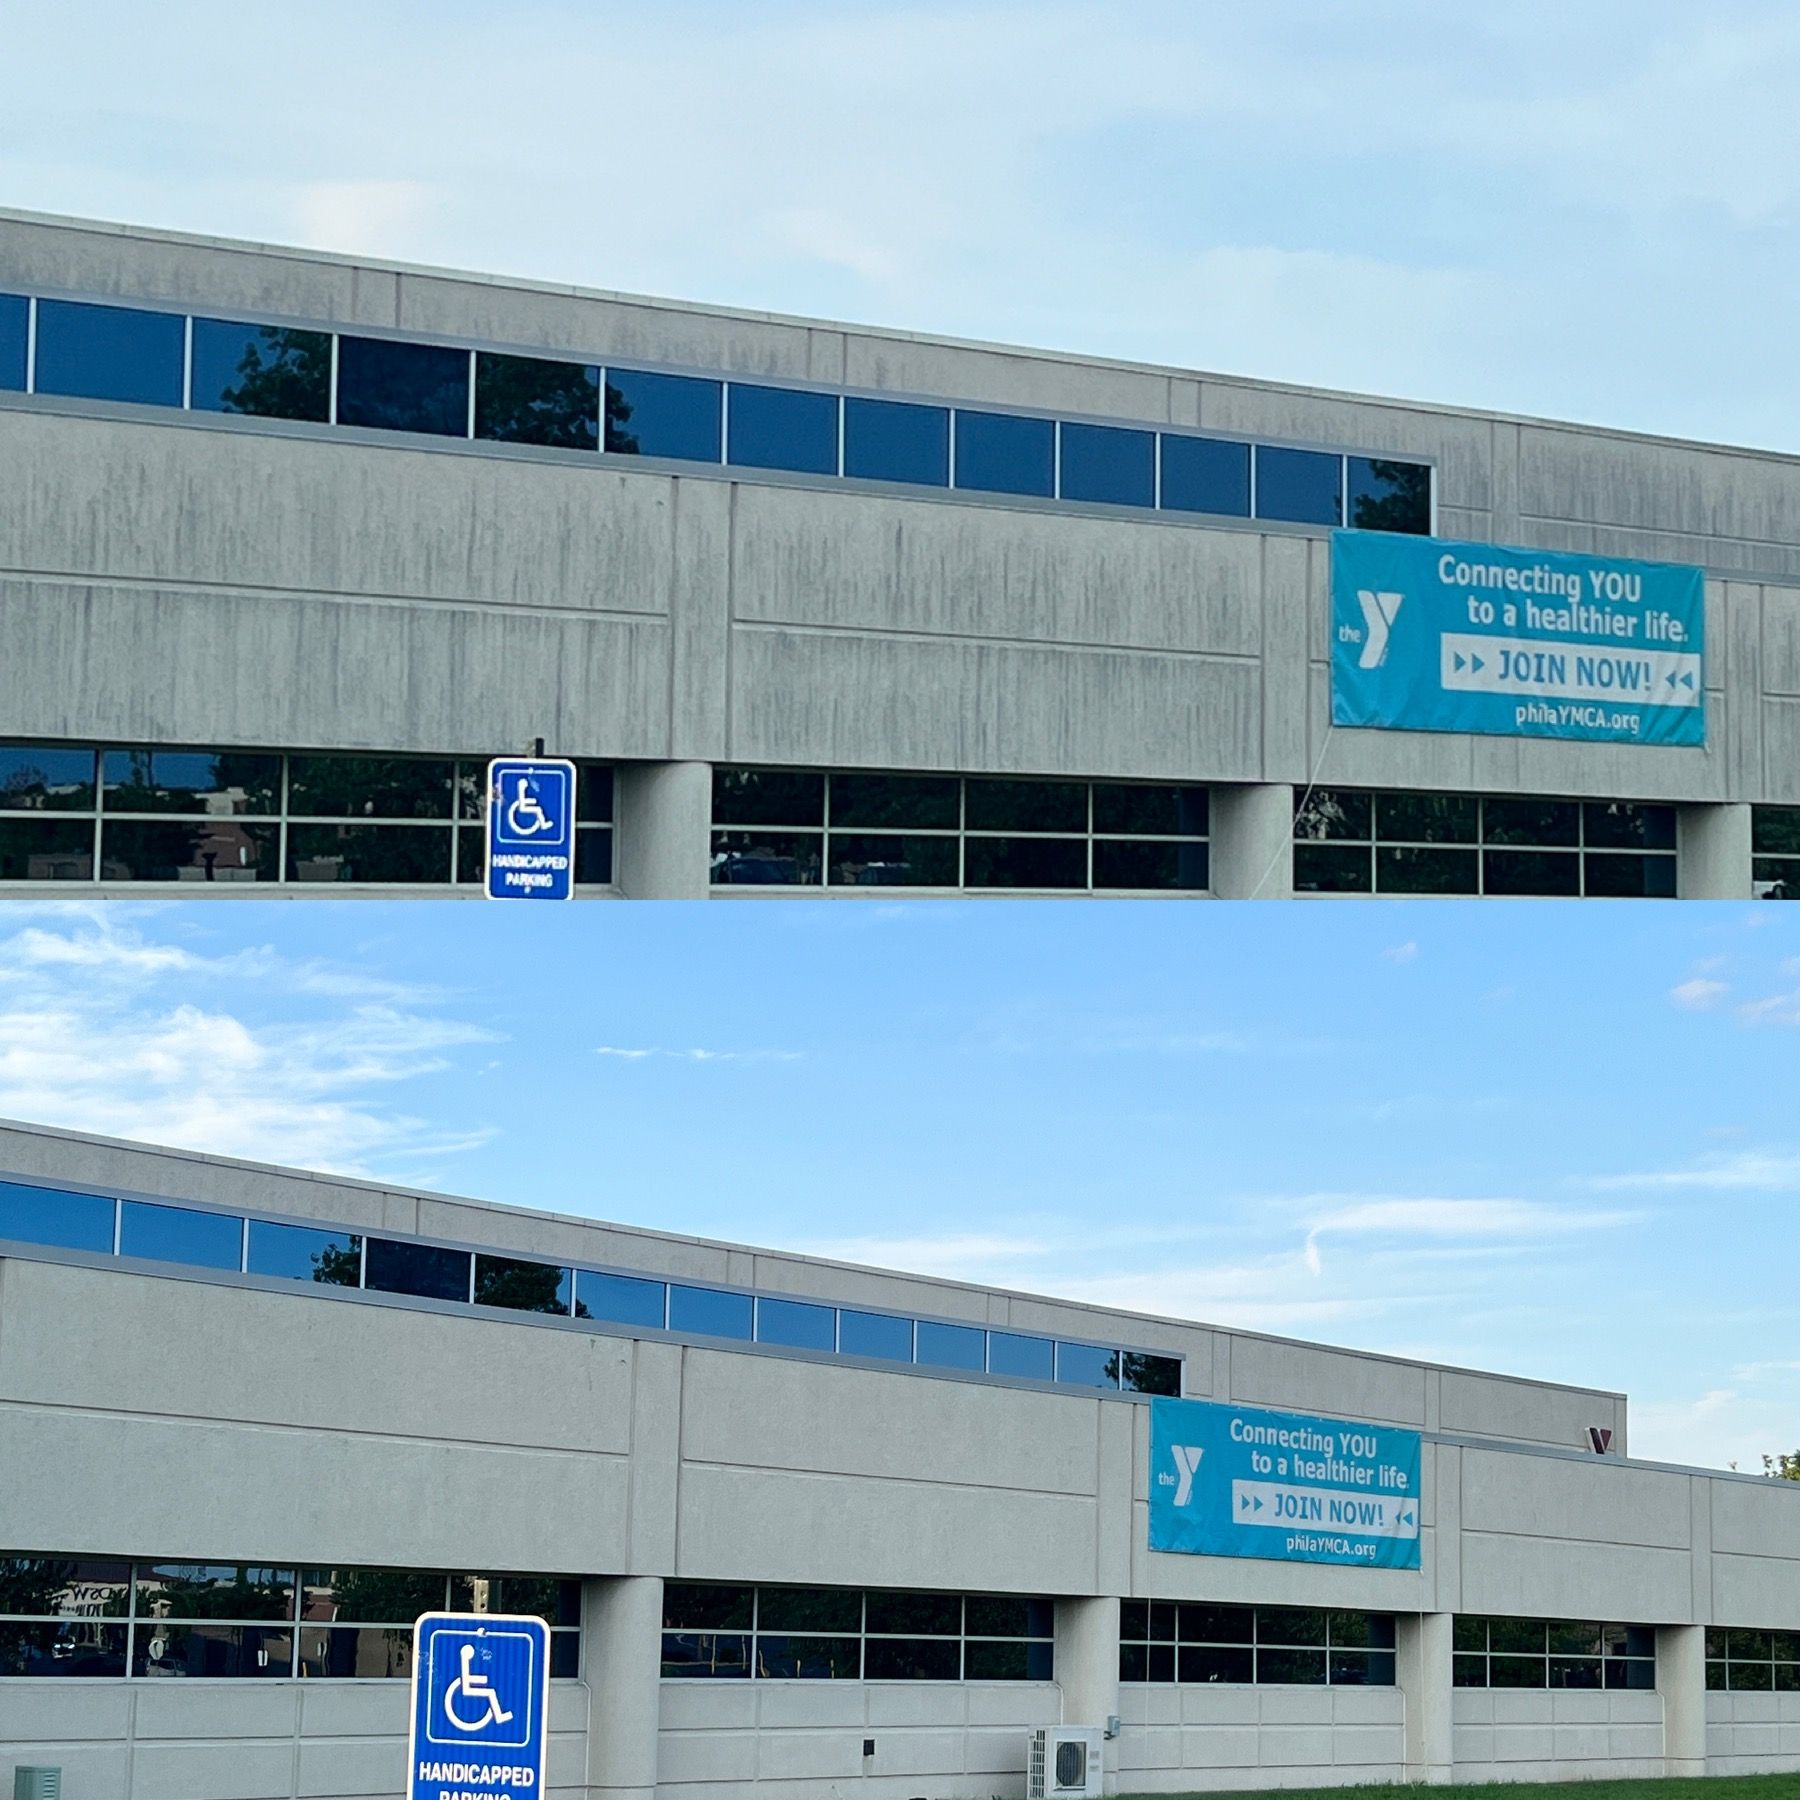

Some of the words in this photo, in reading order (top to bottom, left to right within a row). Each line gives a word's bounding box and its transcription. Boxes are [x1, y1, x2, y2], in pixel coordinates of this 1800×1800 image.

[1438, 554, 1581, 600] Connecting
[1588, 570, 1641, 602] YOU
[1338, 624, 1361, 643] the
[1357, 590, 1405, 669] Y
[1467, 595, 1494, 624] to
[1503, 604, 1517, 627] a
[1526, 599, 1637, 638] healthier
[1644, 610, 1689, 642] life.
[1498, 650, 1566, 685] JOIN
[1576, 656, 1651, 691] NOW!
[1515, 702, 1640, 734] philaYMCA.org
[492, 854, 568, 870] HANDICAPPED
[505, 872, 553, 887] PARKING
[1230, 1418, 1333, 1458] Connecting
[1339, 1433, 1377, 1458] YOU
[1158, 1472, 1175, 1486] the
[1171, 1444, 1204, 1507] Y
[1251, 1450, 1271, 1473] to
[1277, 1457, 1288, 1477] a
[1294, 1456, 1374, 1485] healthier
[1379, 1465, 1409, 1488] life.
[1274, 1493, 1322, 1521] JOIN
[1329, 1501, 1384, 1527] NOW!
[1286, 1535, 1377, 1560] philaYMCA.org
[419, 1761, 535, 1787] HANDICAPPED
